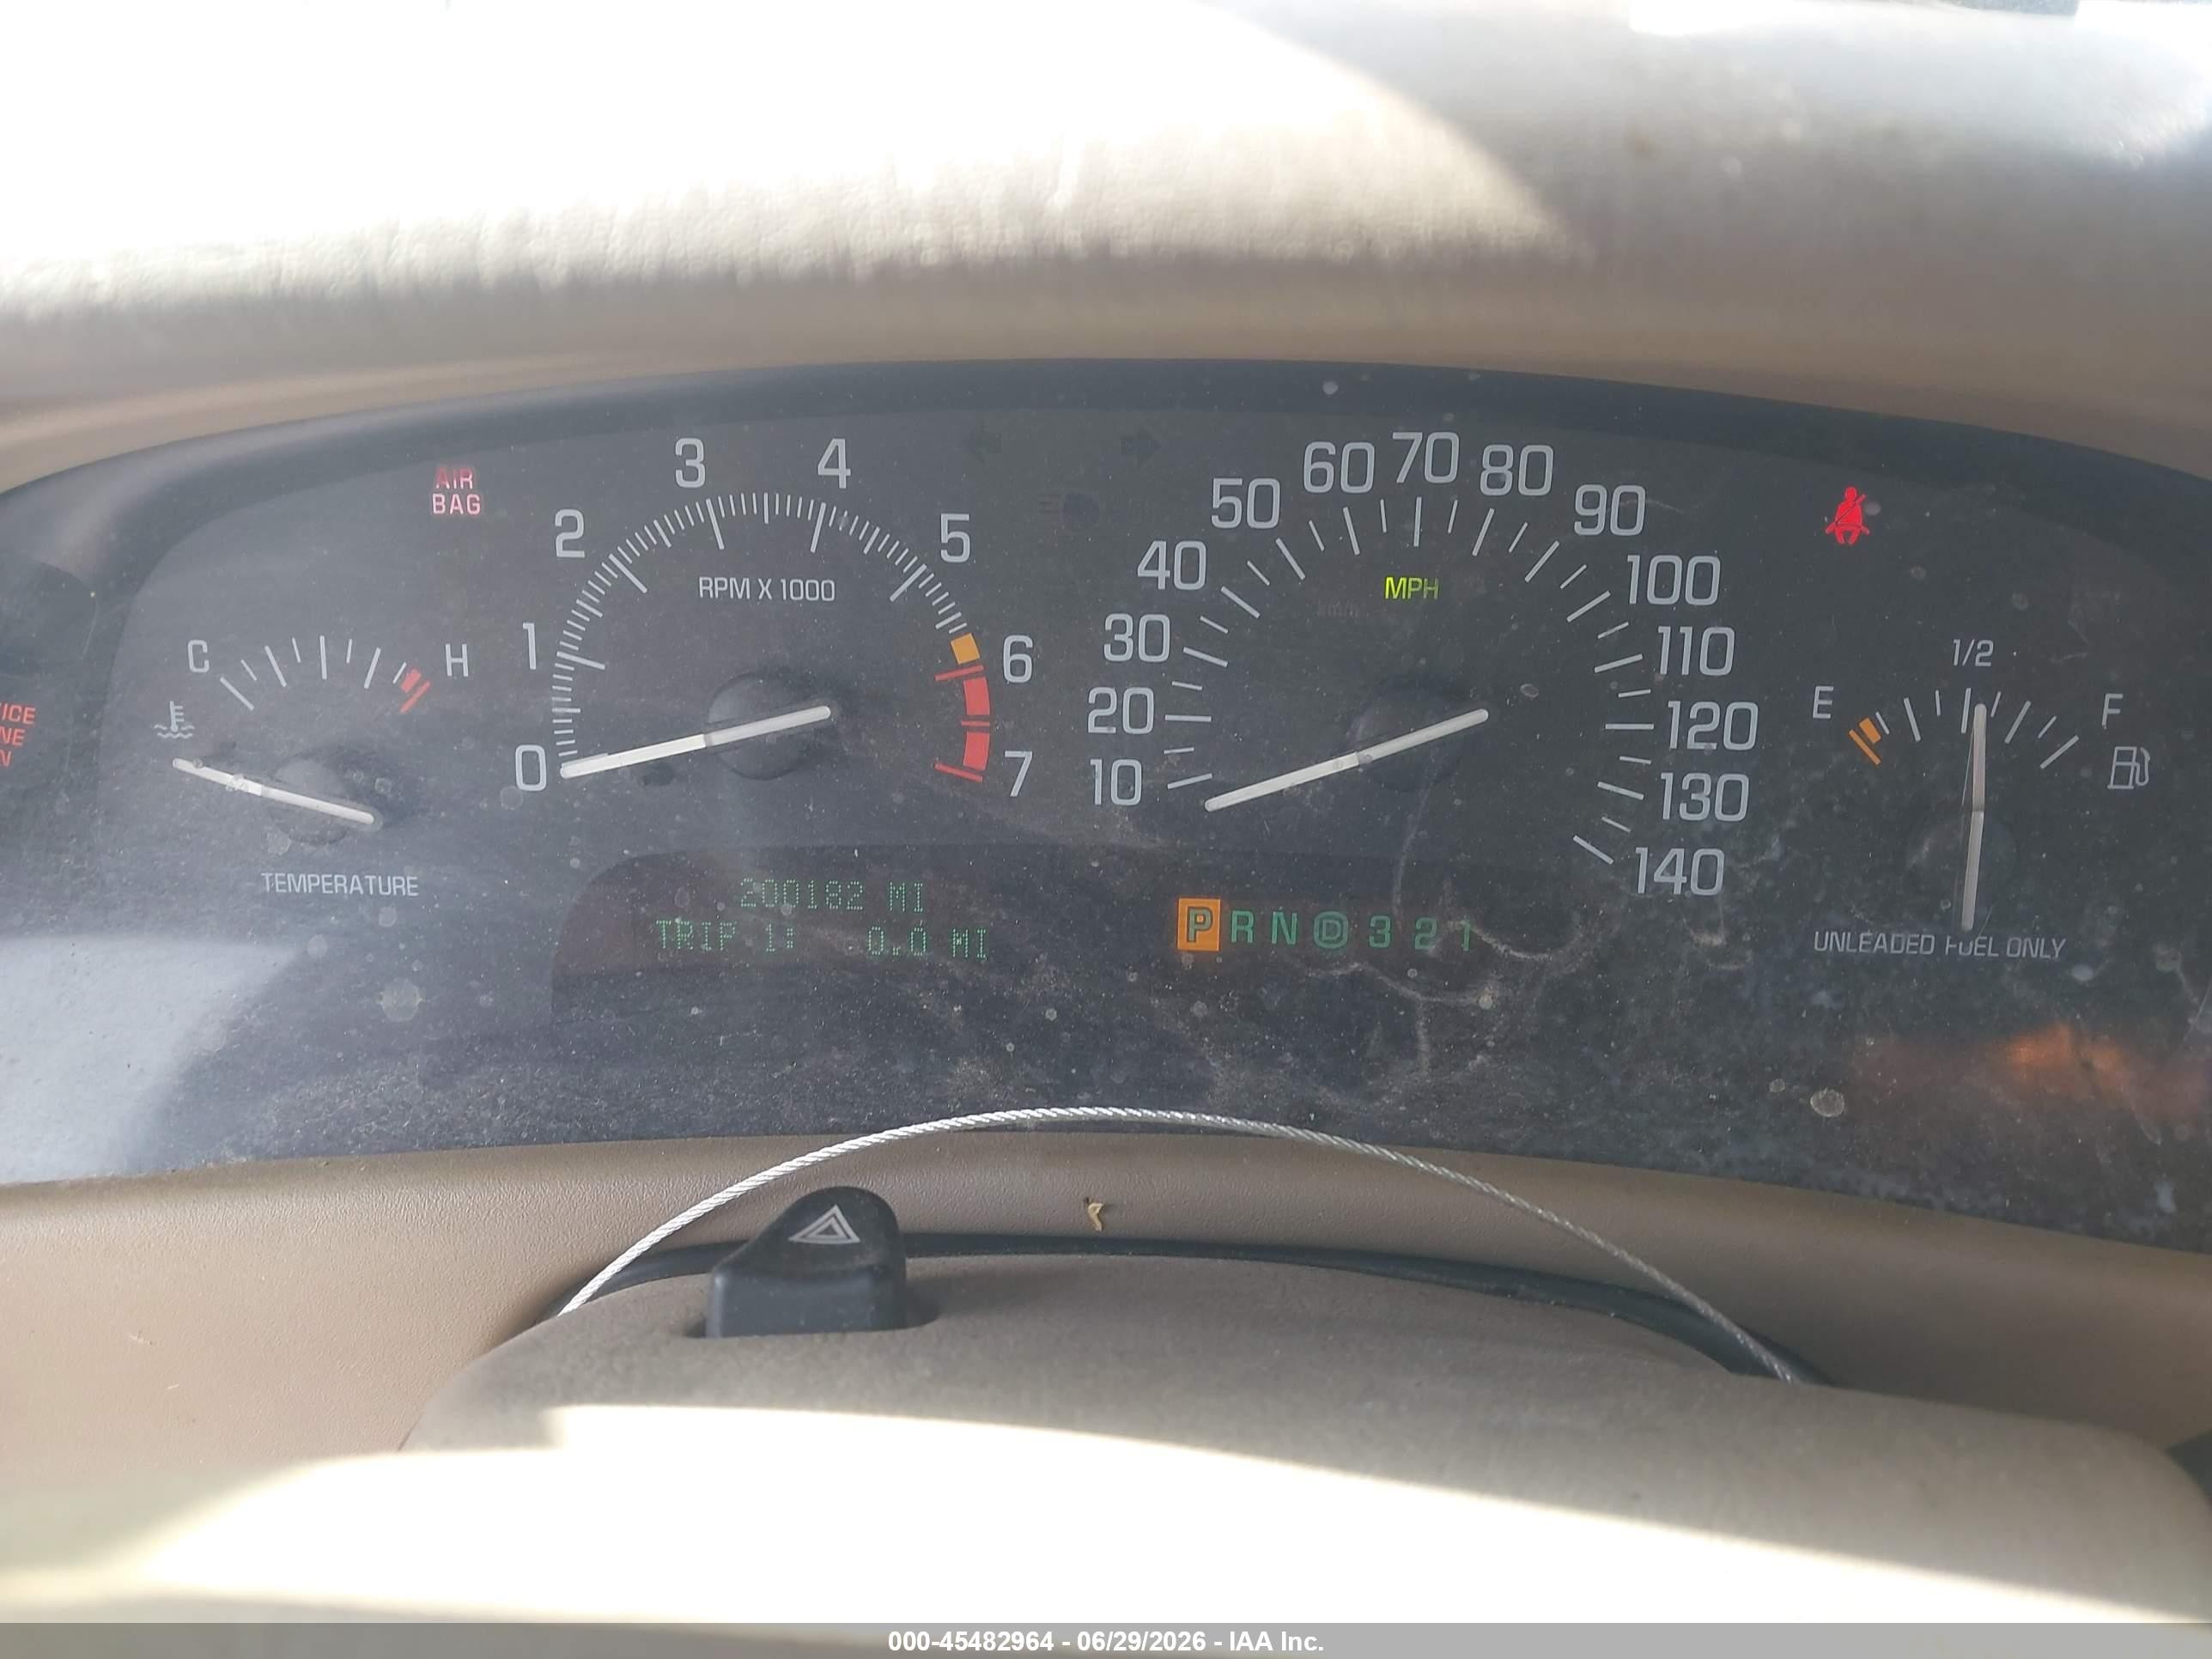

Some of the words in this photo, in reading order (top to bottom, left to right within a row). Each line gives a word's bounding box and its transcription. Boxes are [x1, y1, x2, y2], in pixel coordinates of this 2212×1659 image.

[435, 466, 473, 489] AIR
[675, 437, 706, 489] 3
[817, 438, 851, 489] 4
[1304, 441, 1375, 494] 60
[1392, 431, 1460, 483] 70
[1480, 444, 1554, 496] 80
[432, 493, 481, 515] BAG
[1211, 477, 1280, 529] 50
[1574, 484, 1646, 536] 90
[555, 508, 586, 558] 2
[940, 513, 970, 563] 5
[699, 576, 750, 599] RPM
[757, 578, 773, 600] X
[781, 579, 836, 601] 1000
[1137, 540, 1206, 591] 40
[1384, 576, 1440, 599] MPH
[1627, 555, 1721, 605] 100
[187, 639, 210, 673] C
[445, 643, 469, 678] H
[522, 622, 537, 670] 1
[1003, 635, 1033, 684] 6
[1103, 613, 1170, 663] 30
[1657, 626, 1735, 676] 110
[1953, 638, 1994, 667] 1/2
[1087, 686, 1154, 735] 20
[1668, 700, 1759, 750] 120
[1812, 685, 1834, 720] E
[2101, 693, 2124, 729] F
[514, 744, 547, 792] 0
[1004, 750, 1033, 797] 7
[1090, 758, 1142, 806] 10
[1661, 772, 1749, 822] 130
[260, 872, 419, 896] TEMPERATURE
[740, 878, 864, 910] 200182
[889, 881, 924, 913] MI
[1635, 847, 1725, 896] 140
[655, 920, 737, 951] TRIP
[765, 922, 795, 952] 1:
[867, 926, 927, 957] 0.0
[952, 927, 988, 959] MI
[1188, 906, 1213, 943] P
[1231, 910, 1255, 943] R
[1271, 910, 1297, 945] N
[1370, 915, 1392, 948] 3
[1414, 918, 1437, 950] 2
[1814, 930, 1936, 955] UNLEADED
[1945, 935, 2000, 957] FUEL
[2006, 937, 2067, 959] ONLY
